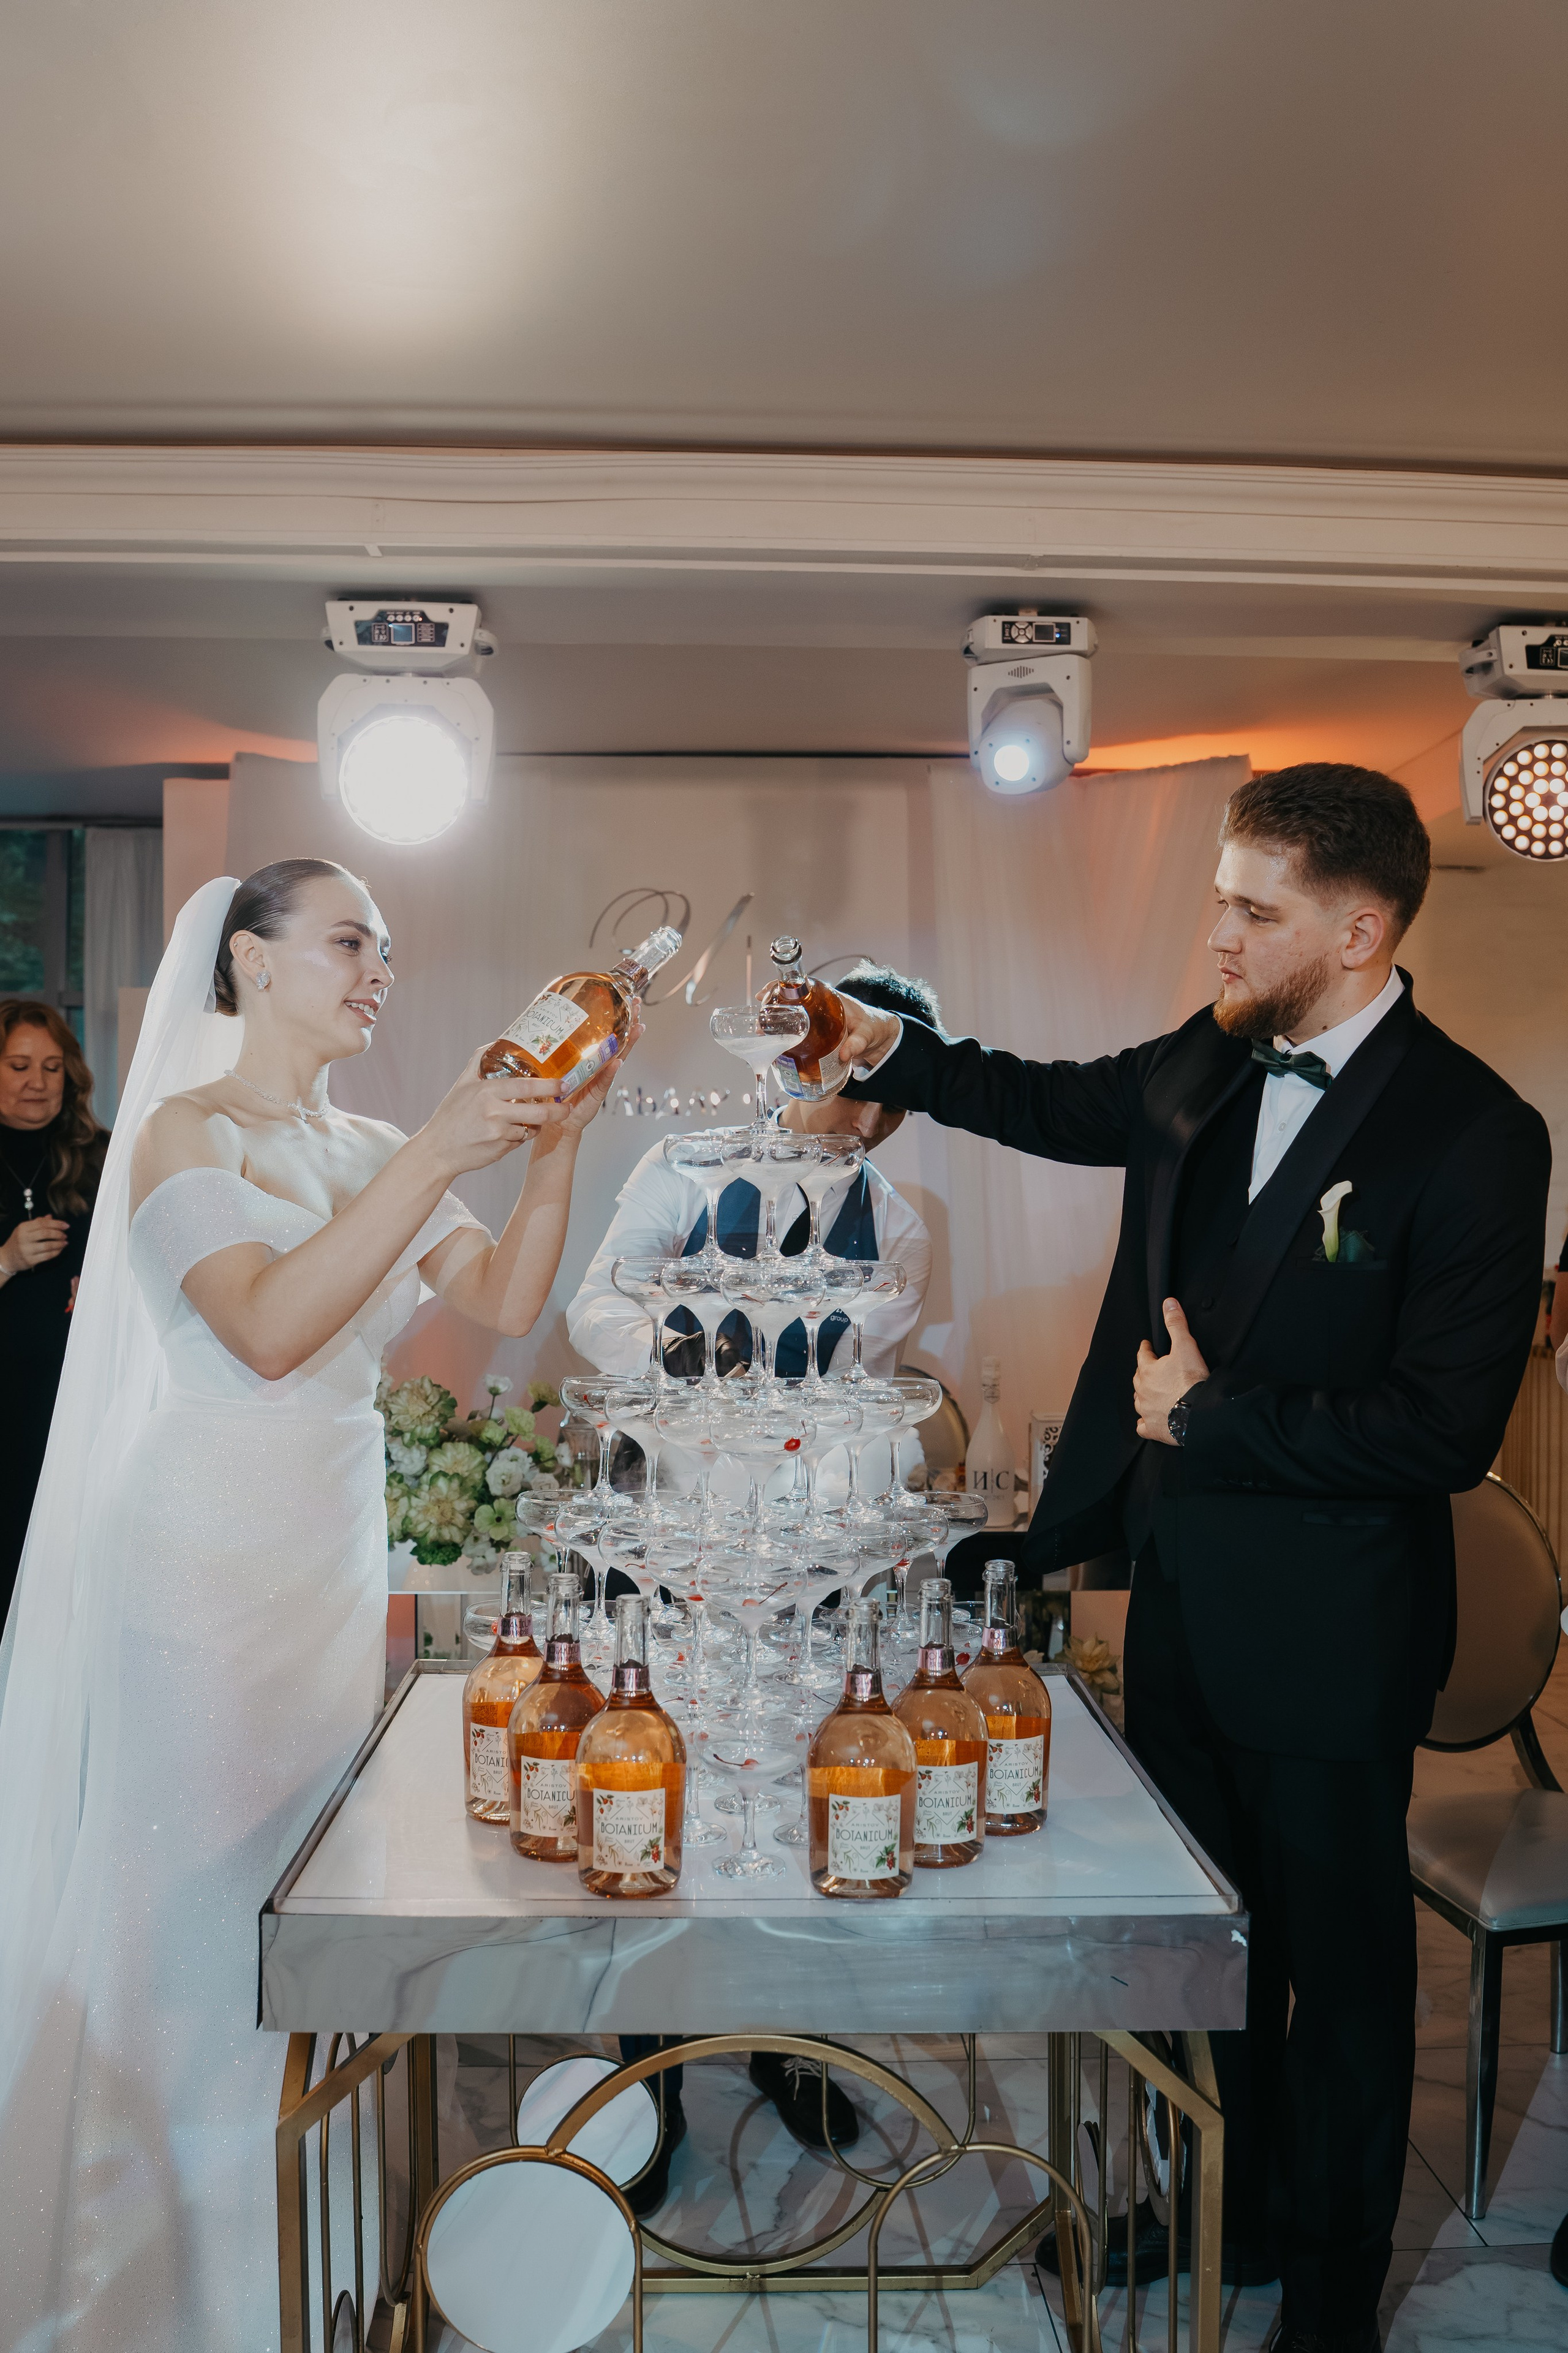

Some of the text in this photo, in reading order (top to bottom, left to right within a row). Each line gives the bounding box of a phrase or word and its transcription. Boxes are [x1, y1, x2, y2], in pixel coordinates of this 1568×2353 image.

[475, 1753, 508, 1767] BOTANIC
[990, 1766, 1038, 1780] BOTANICUM
[527, 1788, 575, 1801] BOTANICU
[919, 1794, 971, 1808] BOTANICUM
[601, 1822, 657, 1835] BOTANICUM
[836, 1828, 893, 1842] BOTANICUM
